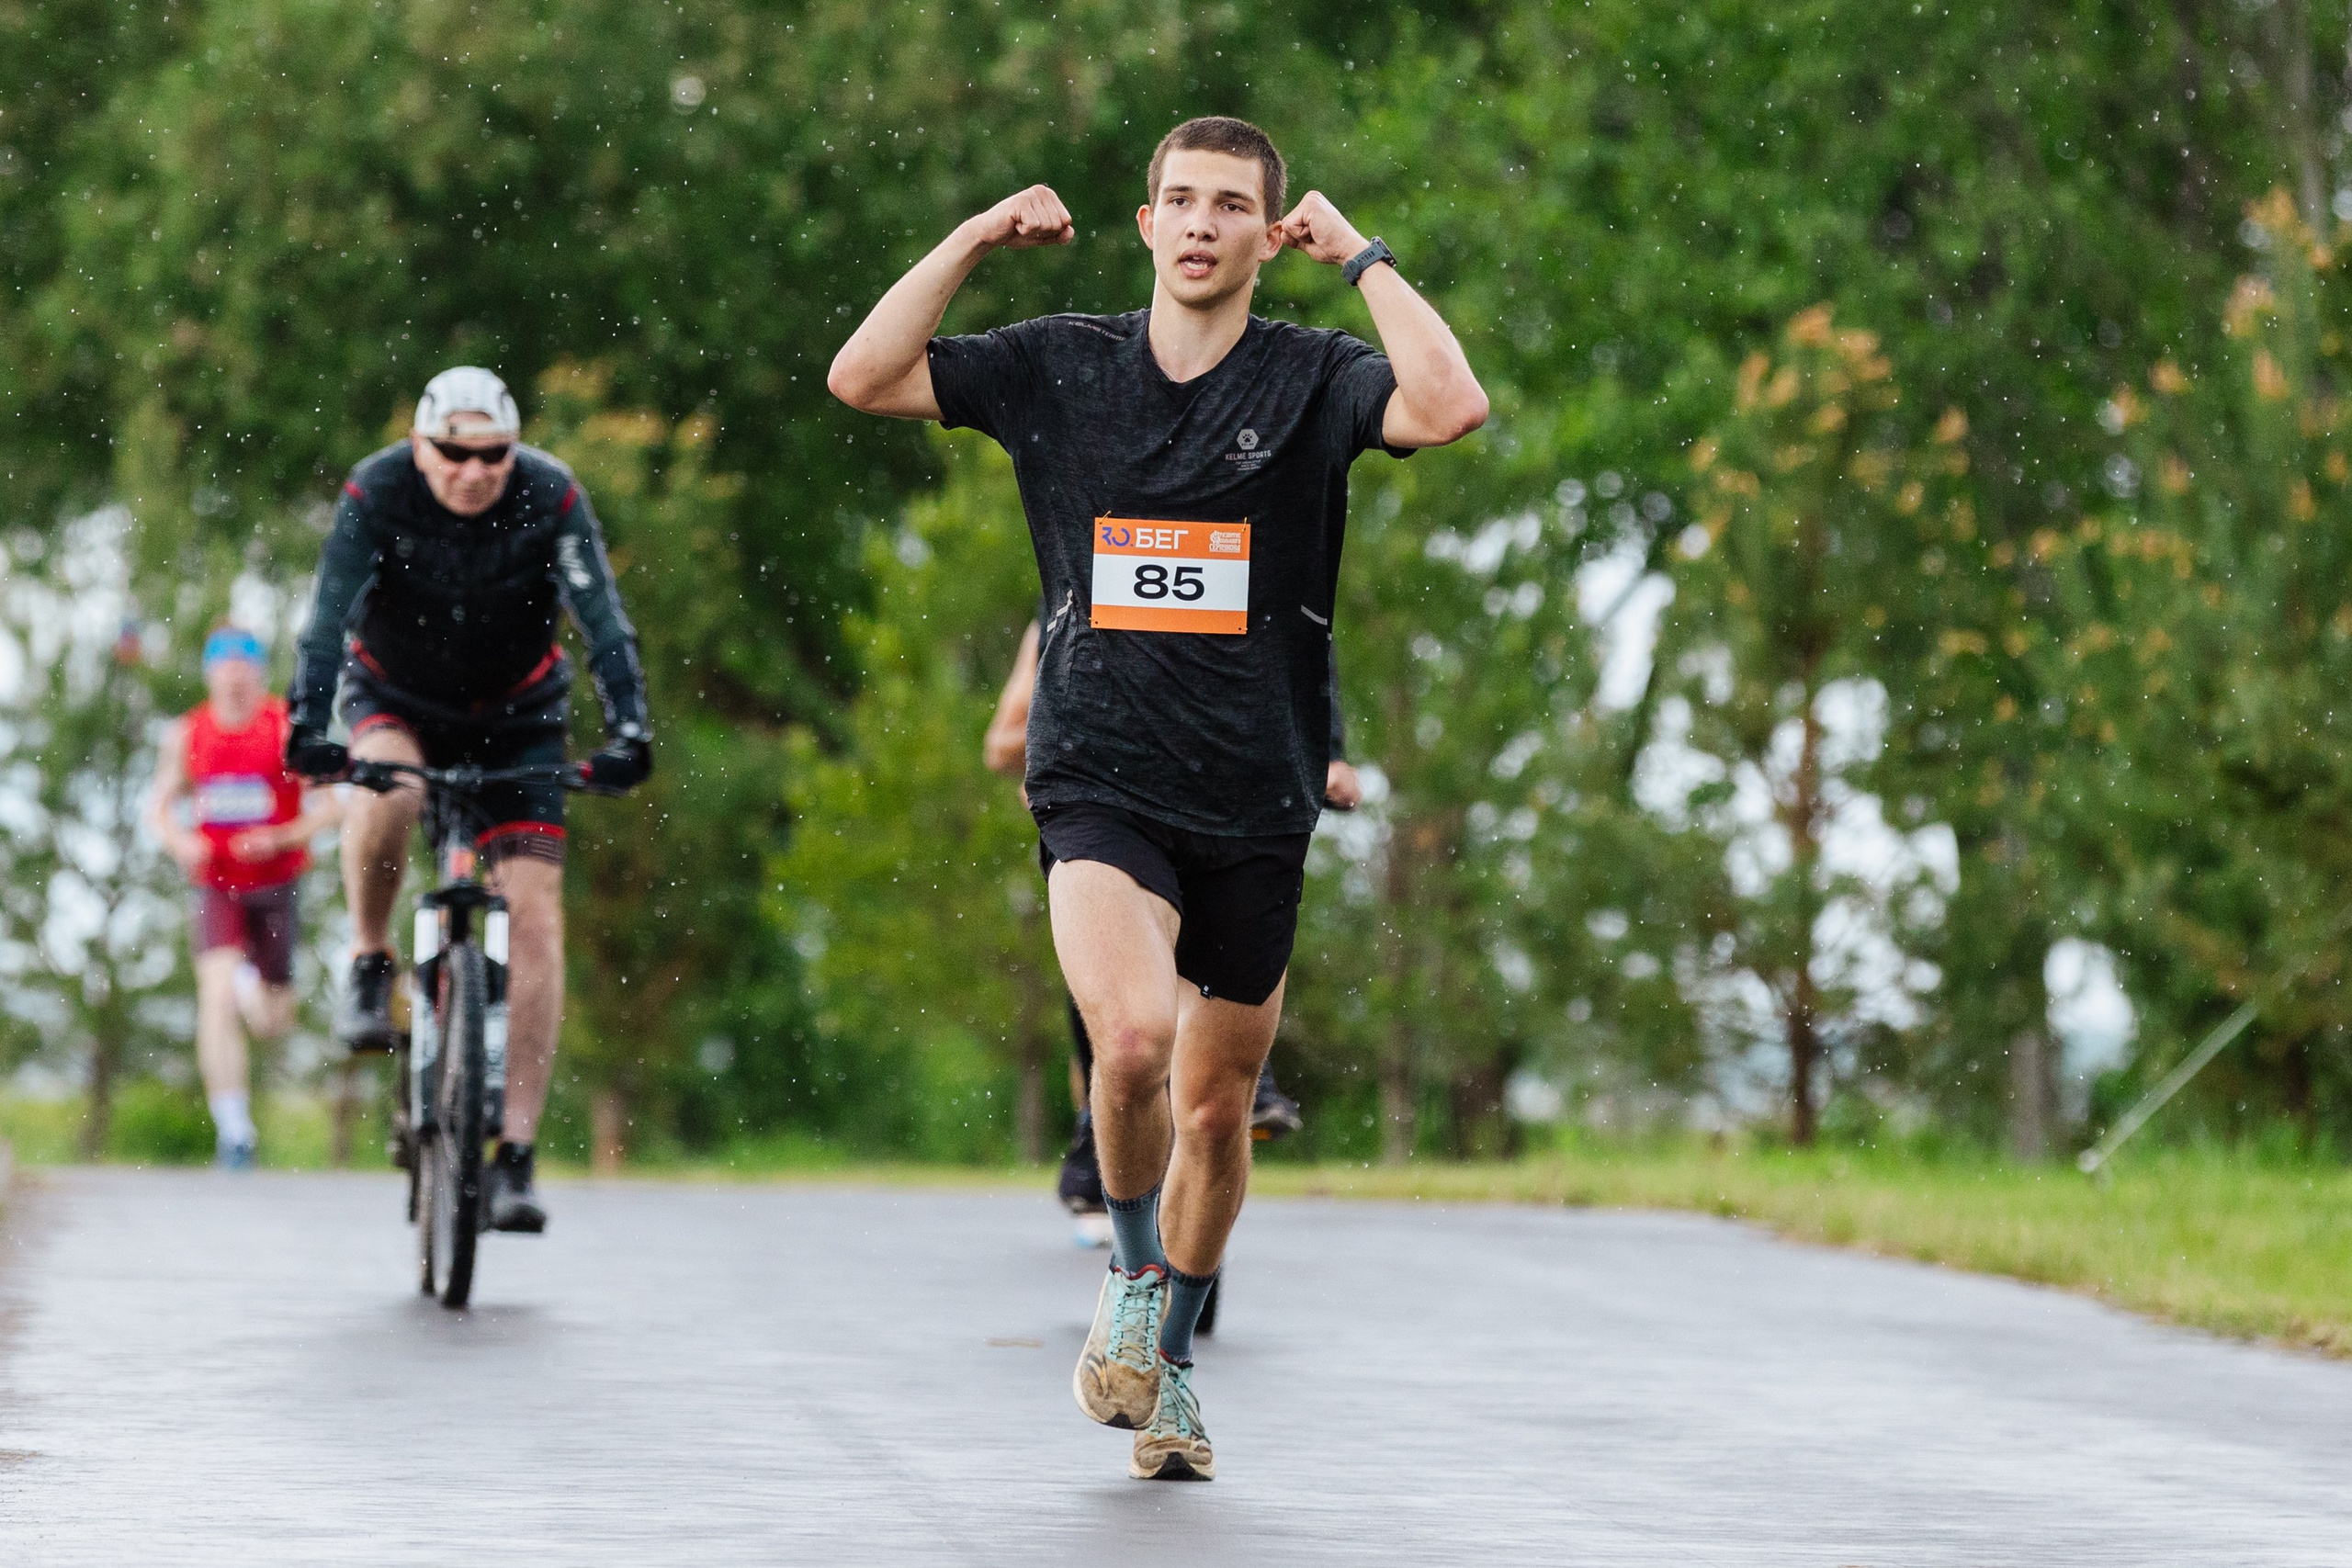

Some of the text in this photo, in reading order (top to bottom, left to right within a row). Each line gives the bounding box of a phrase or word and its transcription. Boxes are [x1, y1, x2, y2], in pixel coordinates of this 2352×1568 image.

[1225, 450, 1272, 460] KELME SPORTS
[1133, 564, 1204, 601] 85
